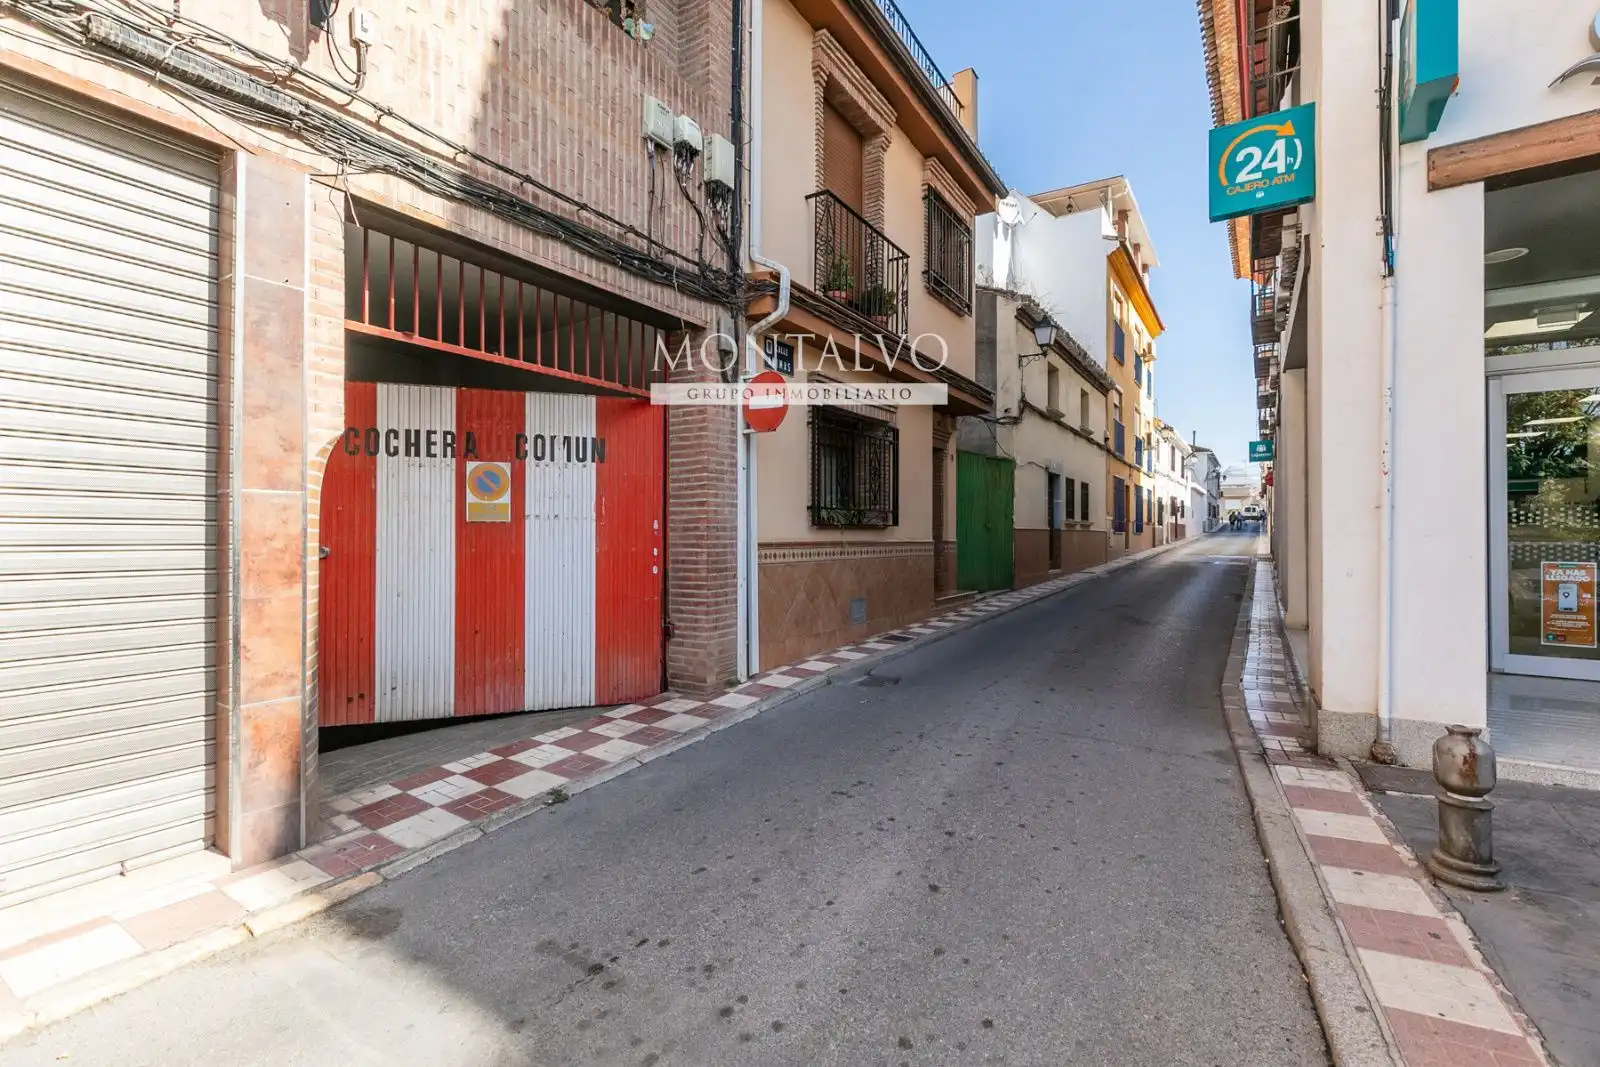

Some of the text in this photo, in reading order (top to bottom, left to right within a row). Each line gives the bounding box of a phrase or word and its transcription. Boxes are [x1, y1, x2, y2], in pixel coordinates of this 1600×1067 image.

[1226, 173, 1296, 196] CAJERO ATM
[343, 426, 479, 460] COCHERA
[1545, 574, 1591, 582] LLEGADO
